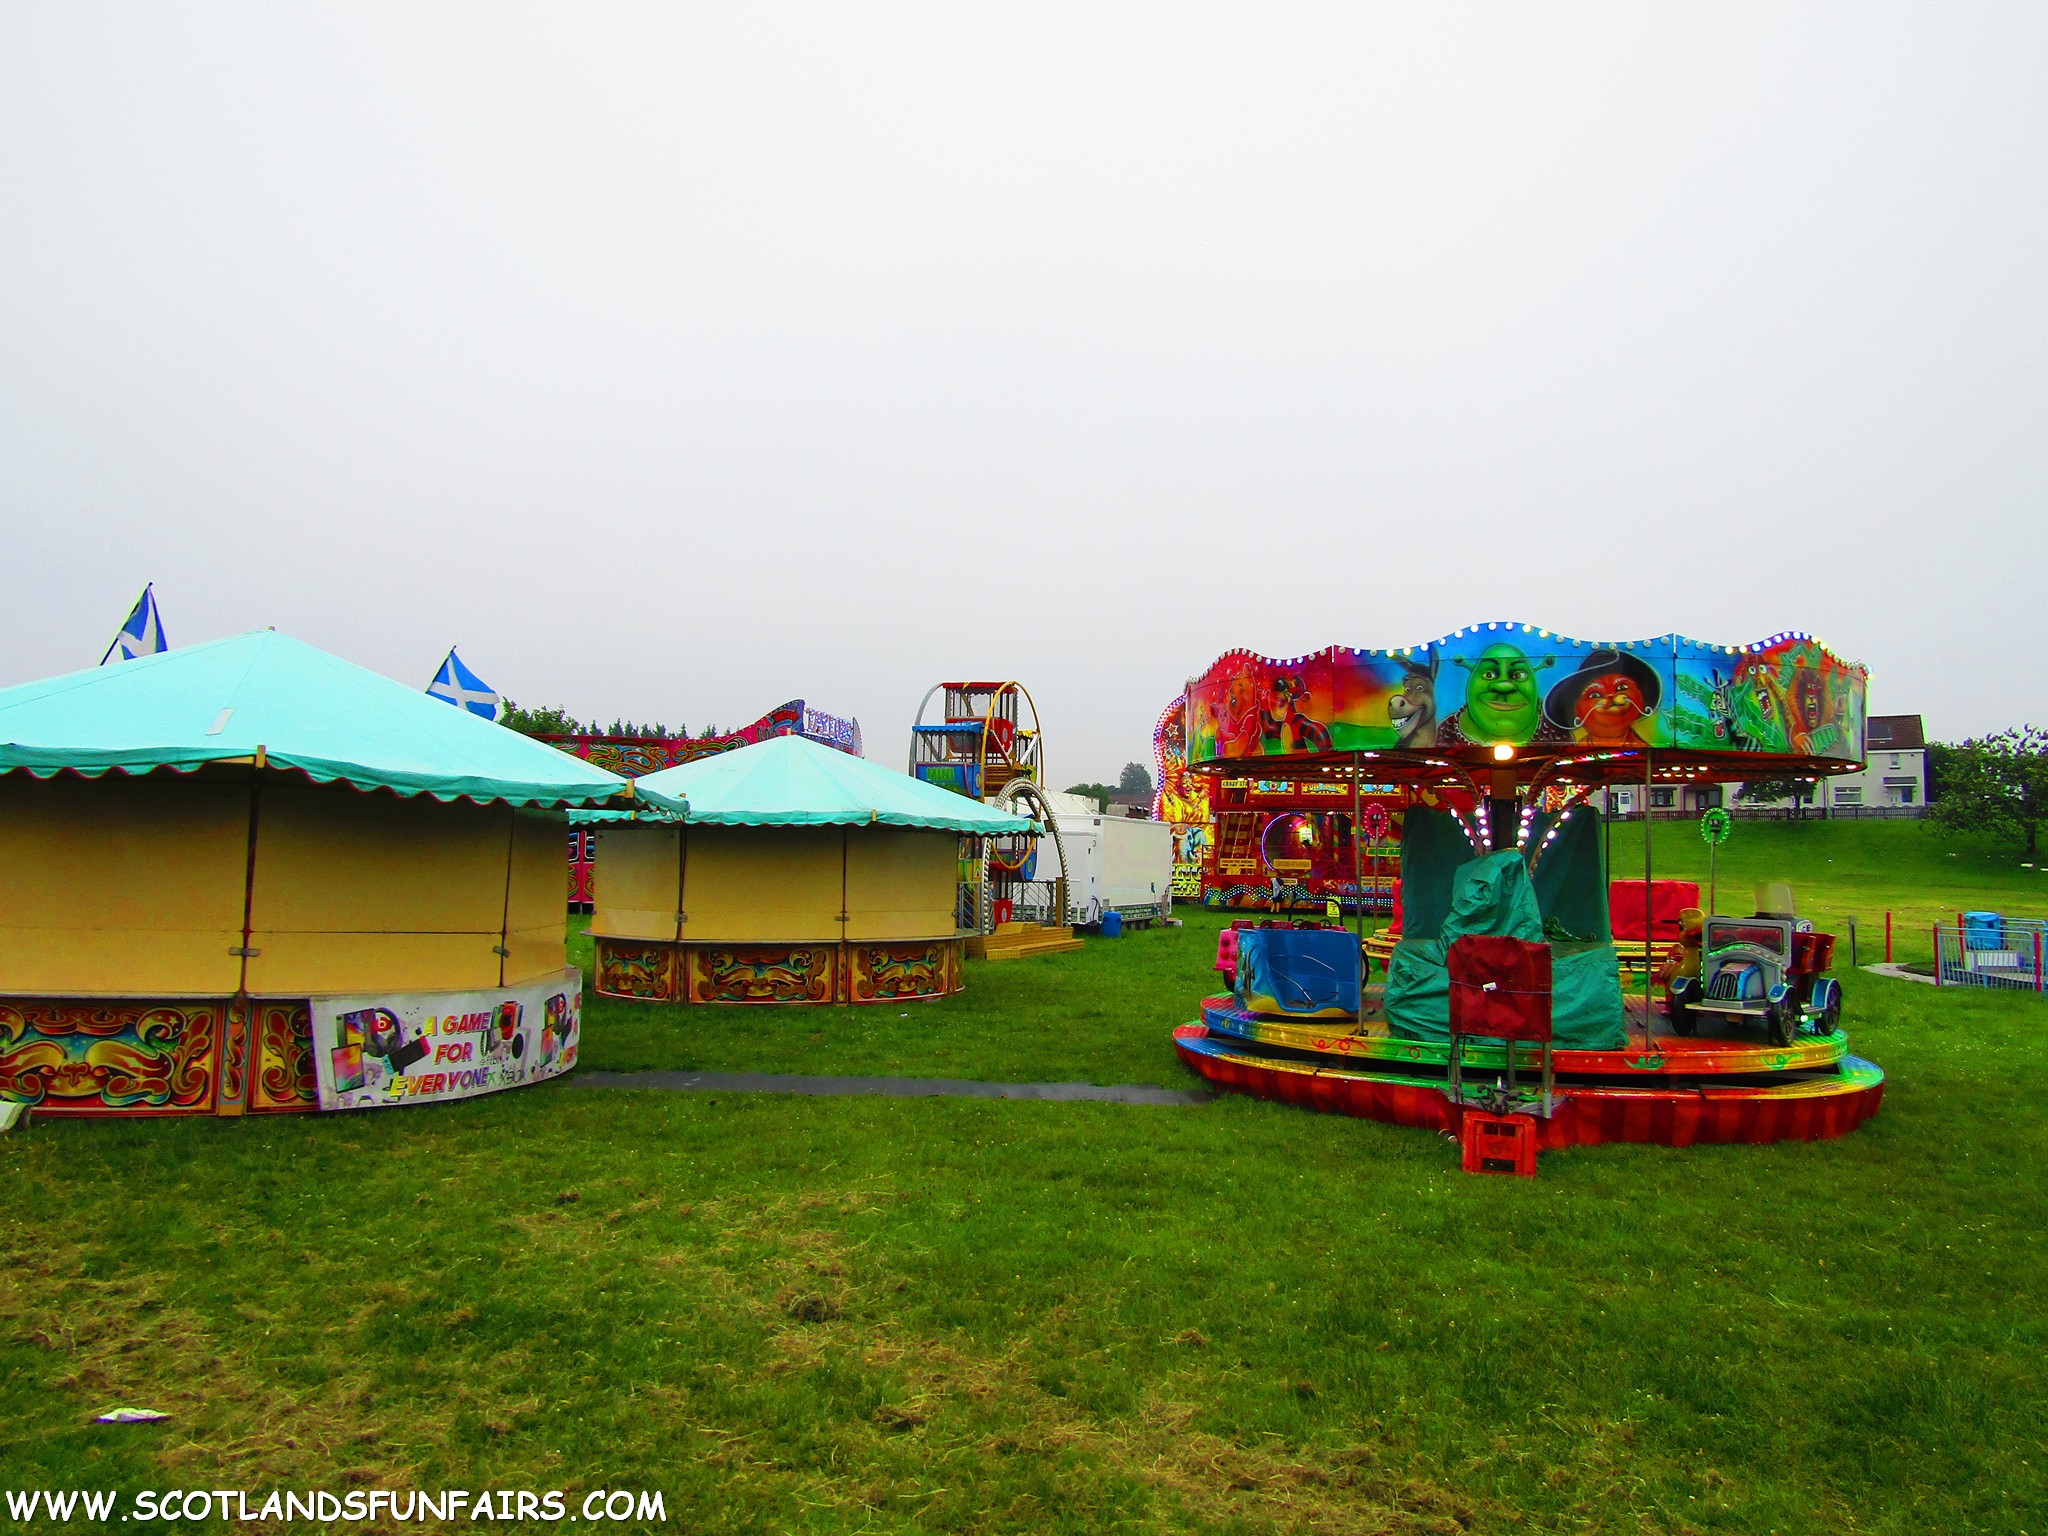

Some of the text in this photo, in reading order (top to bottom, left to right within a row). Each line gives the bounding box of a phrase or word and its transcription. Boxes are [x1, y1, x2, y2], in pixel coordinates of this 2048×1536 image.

[422, 1011, 492, 1036] A GAME
[434, 1041, 473, 1065] FOR
[389, 1066, 490, 1097] EVERYONE
